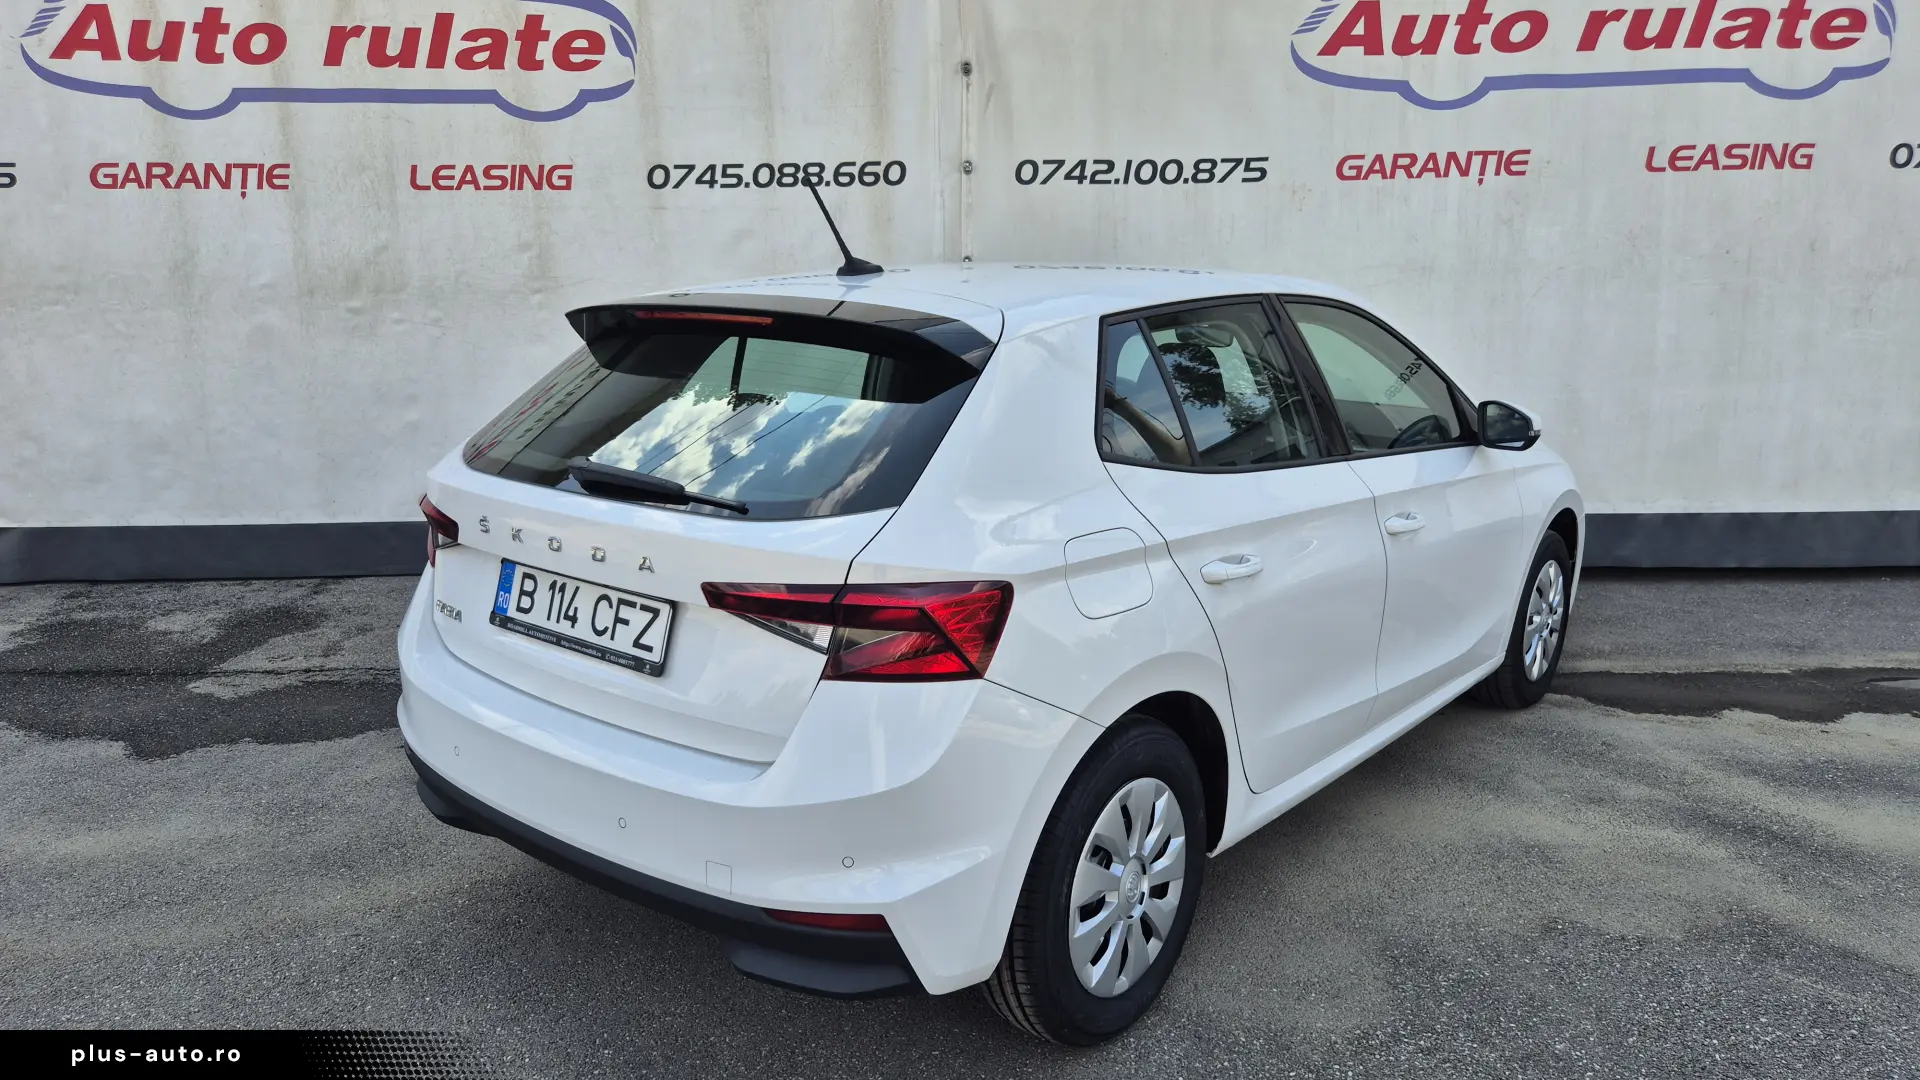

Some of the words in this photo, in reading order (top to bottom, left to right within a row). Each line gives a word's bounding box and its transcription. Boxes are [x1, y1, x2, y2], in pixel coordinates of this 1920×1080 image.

[48, 3, 288, 66] Auto
[322, 13, 607, 73] rulate
[1316, 0, 1549, 57] Auto
[1575, 0, 1868, 52] rulate
[1014, 156, 1269, 186] 0742.100.875
[1335, 149, 1532, 187] GARANȚIE
[1644, 142, 1816, 173] LEASING
[1889, 142, 1920, 169] 0
[89, 162, 291, 200] GARANȚIE
[409, 164, 573, 192] LEASING
[646, 160, 907, 190] 0745.088.660
[496, 590, 511, 610] RO
[515, 571, 539, 615] B
[546, 579, 581, 629] 114
[590, 593, 662, 654] CFZ
